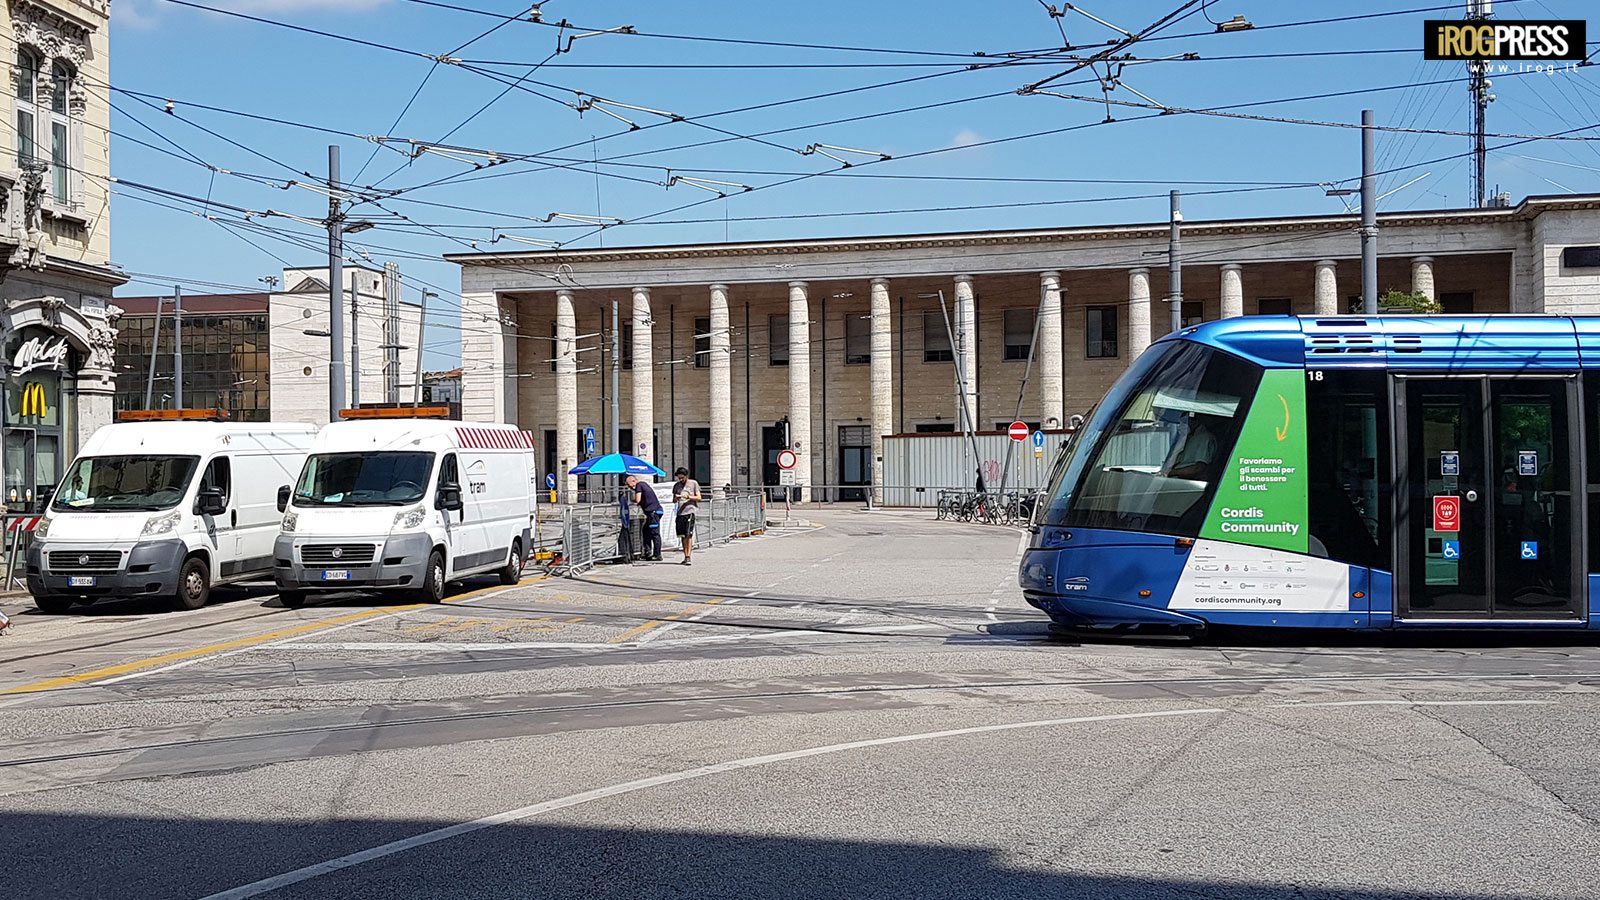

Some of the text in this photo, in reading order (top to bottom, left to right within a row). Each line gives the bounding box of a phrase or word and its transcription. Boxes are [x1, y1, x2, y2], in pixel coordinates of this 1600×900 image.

[1307, 370, 1324, 381] 18
[1239, 457, 1283, 465] Favoriamo
[1239, 466, 1250, 475] gli
[1281, 467, 1296, 475] per
[469, 480, 487, 494] tram
[1239, 483, 1268, 491] di tutti.
[1220, 506, 1264, 518] Cordis
[1220, 521, 1300, 536] Community
[1065, 583, 1088, 591] tram
[1194, 596, 1282, 606] cordiscommunity.org
